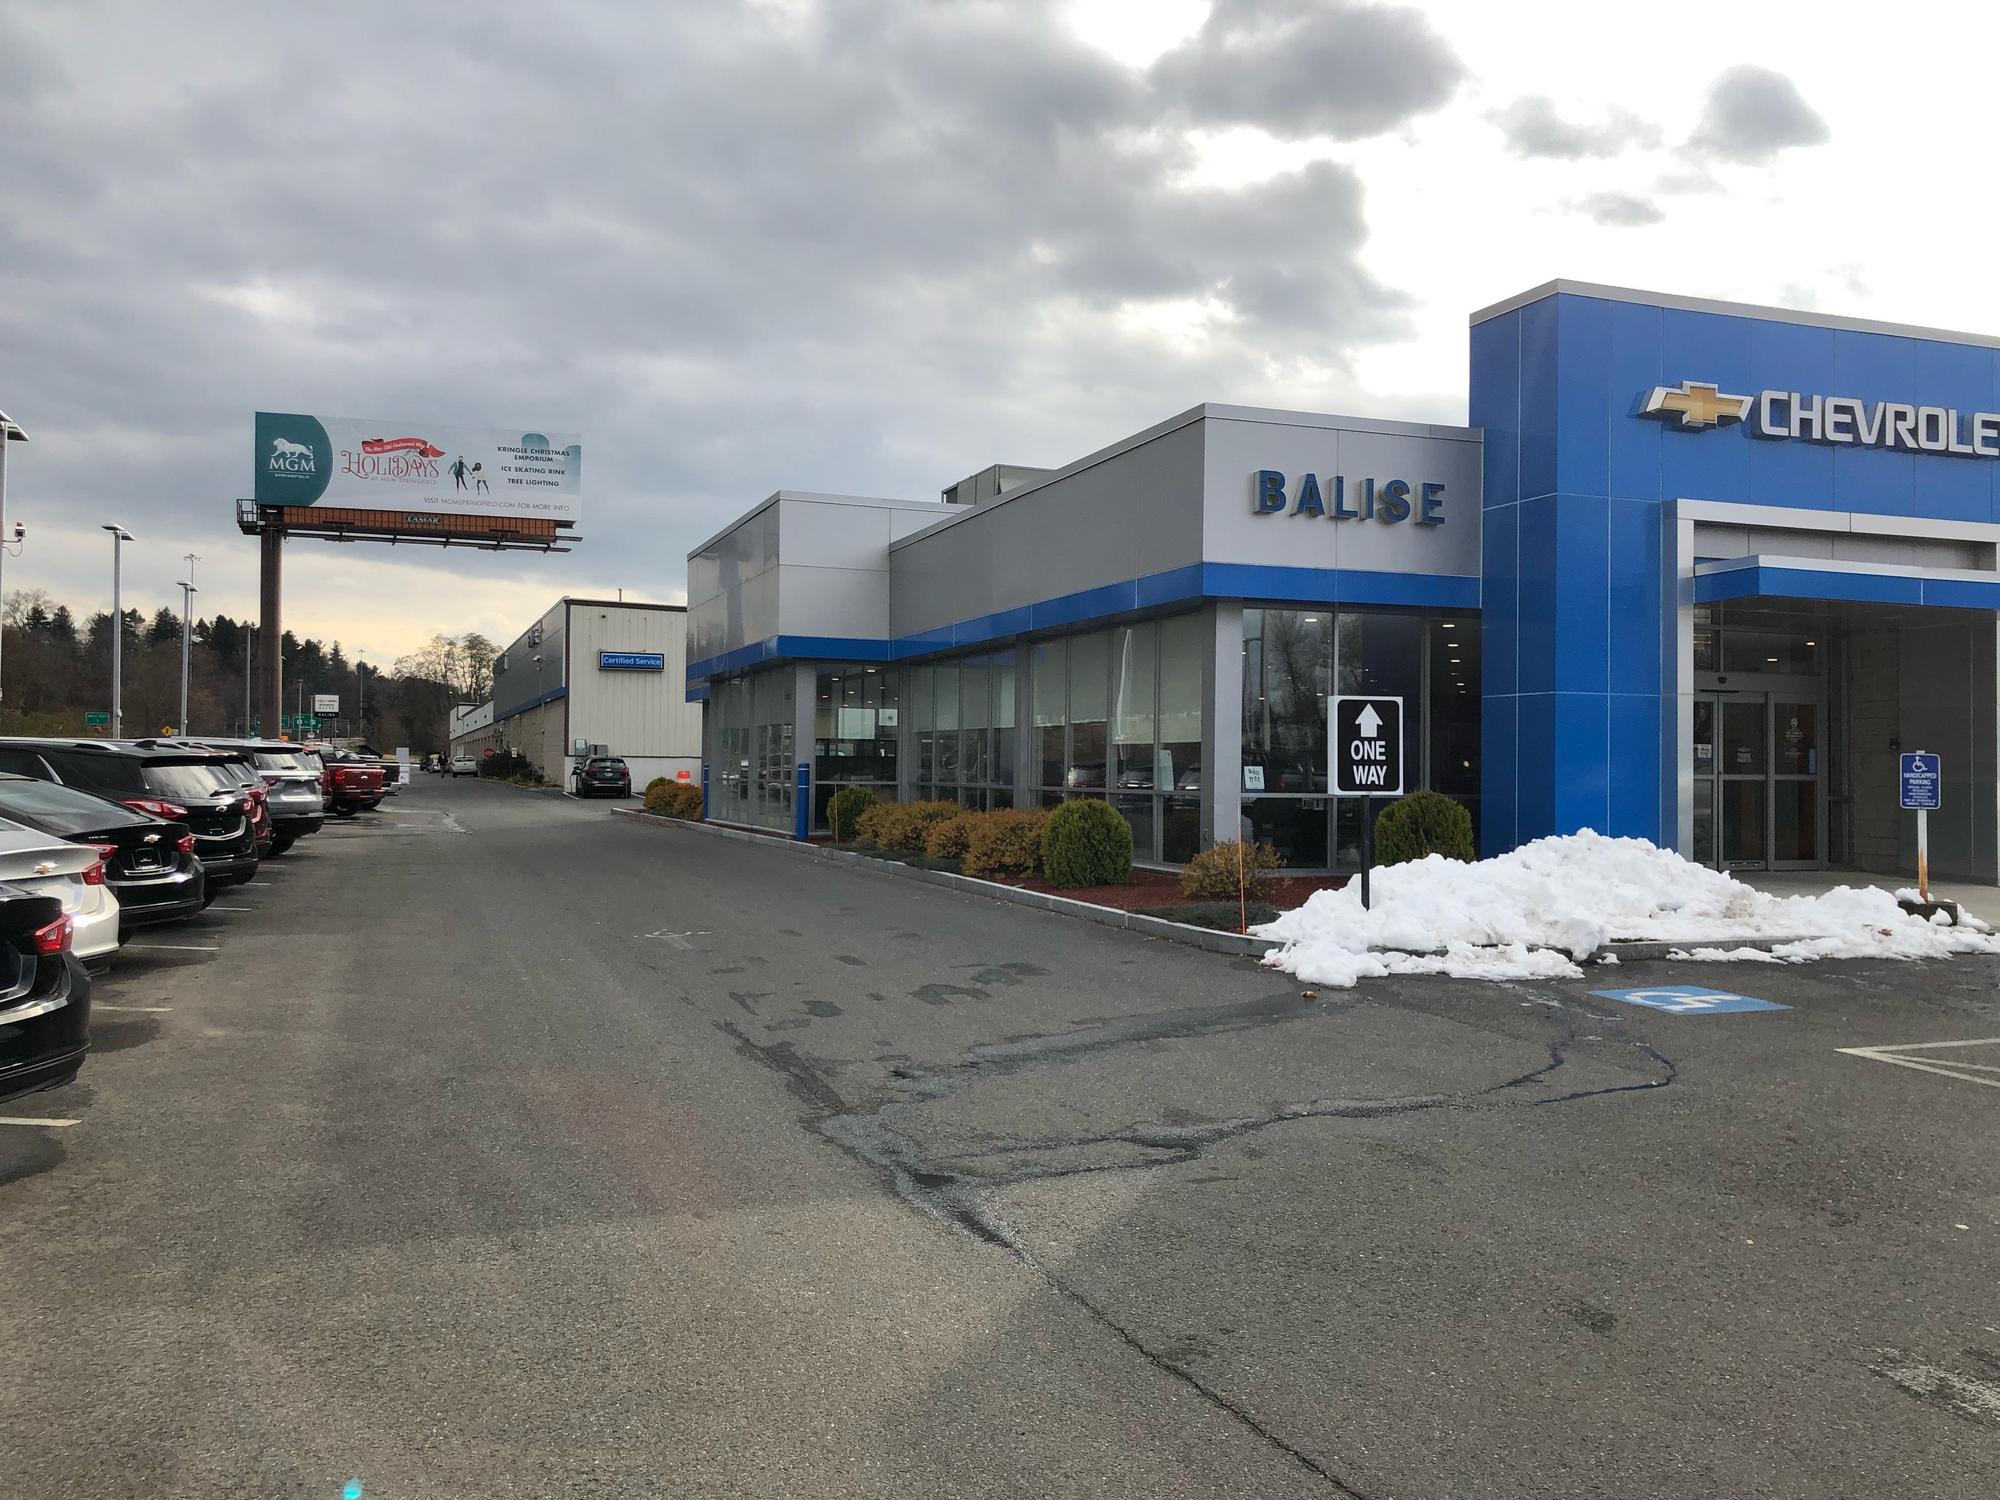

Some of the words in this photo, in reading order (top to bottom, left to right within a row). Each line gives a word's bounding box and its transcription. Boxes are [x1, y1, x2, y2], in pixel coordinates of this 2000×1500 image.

[497, 446, 528, 454] KRINGLE
[530, 448, 570, 457] CHRISTMAS
[269, 457, 316, 472] MGM
[341, 450, 439, 479] HOLIDAYS
[514, 455, 554, 463] EMPORIUM
[526, 479, 560, 487] LIGHTING
[1253, 470, 1446, 525] BALISE
[406, 515, 439, 524] LAMAR
[603, 656, 634, 664] Certified
[1350, 740, 1386, 760] ONE
[1352, 765, 1388, 785] WAY
